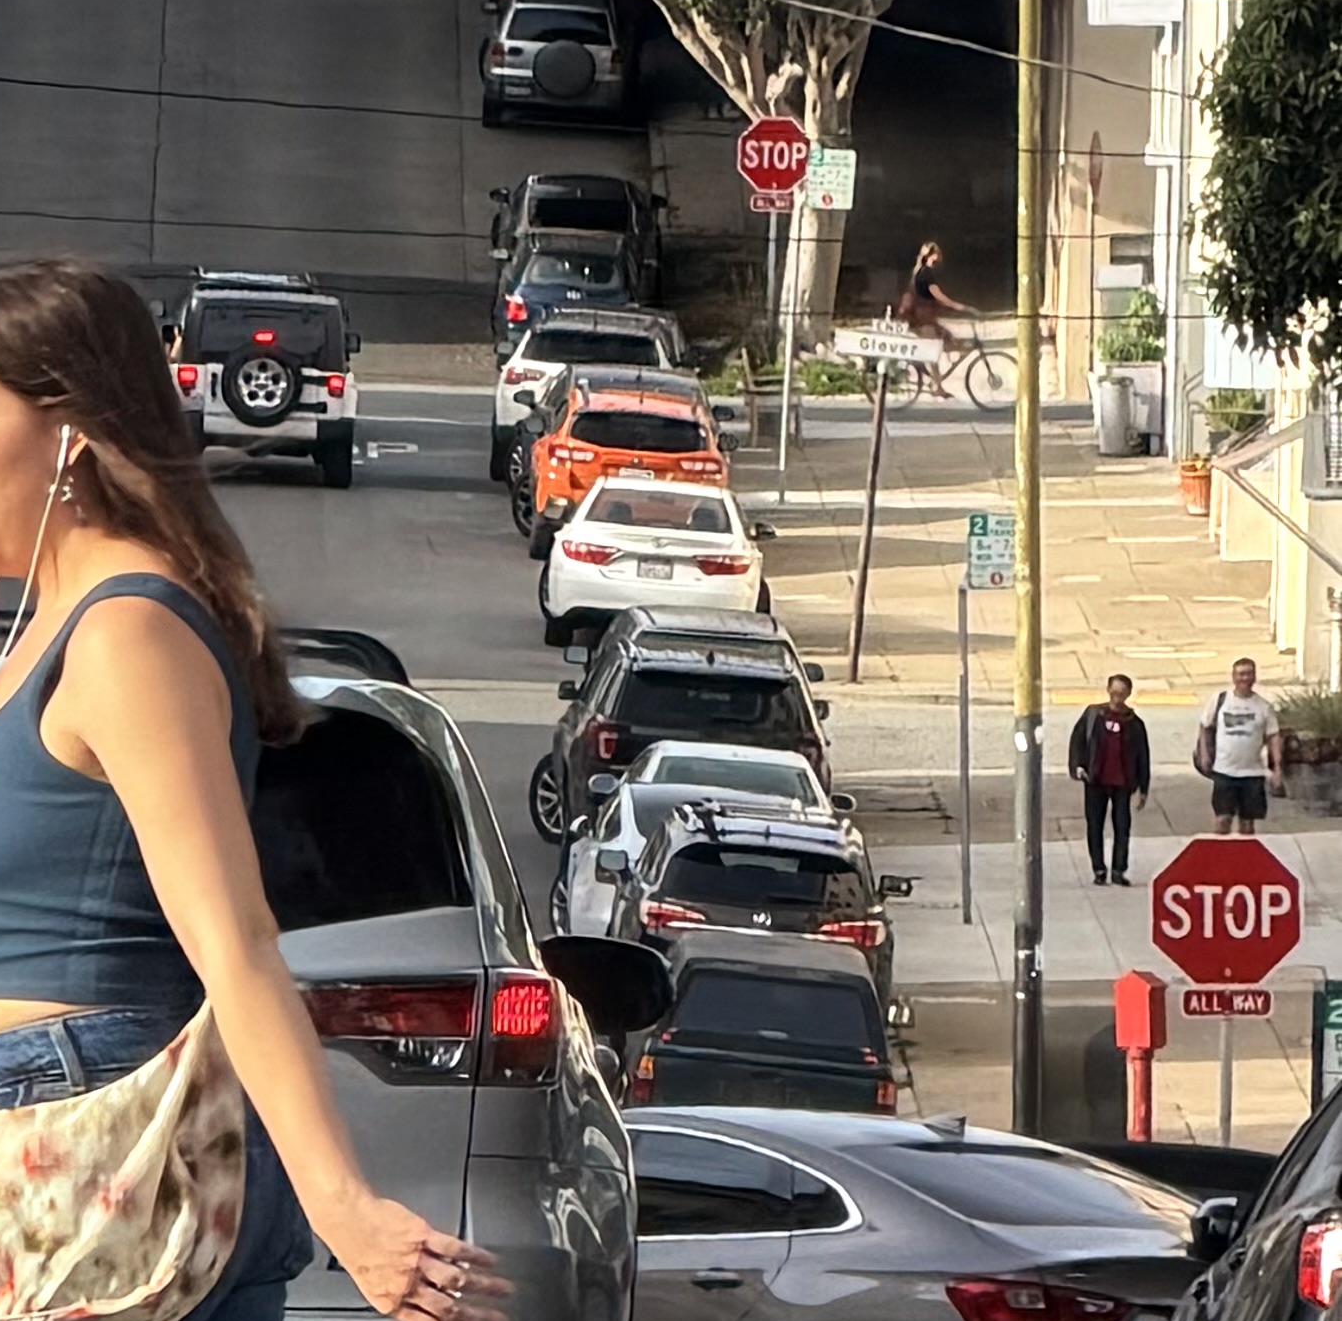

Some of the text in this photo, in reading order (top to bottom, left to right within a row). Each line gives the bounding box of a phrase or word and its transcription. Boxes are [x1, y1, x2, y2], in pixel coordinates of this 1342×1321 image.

[744, 140, 807, 171] STOP
[973, 517, 984, 534] 2
[1160, 884, 1291, 939] STOP
[1189, 994, 1265, 1011] ALL WAY
